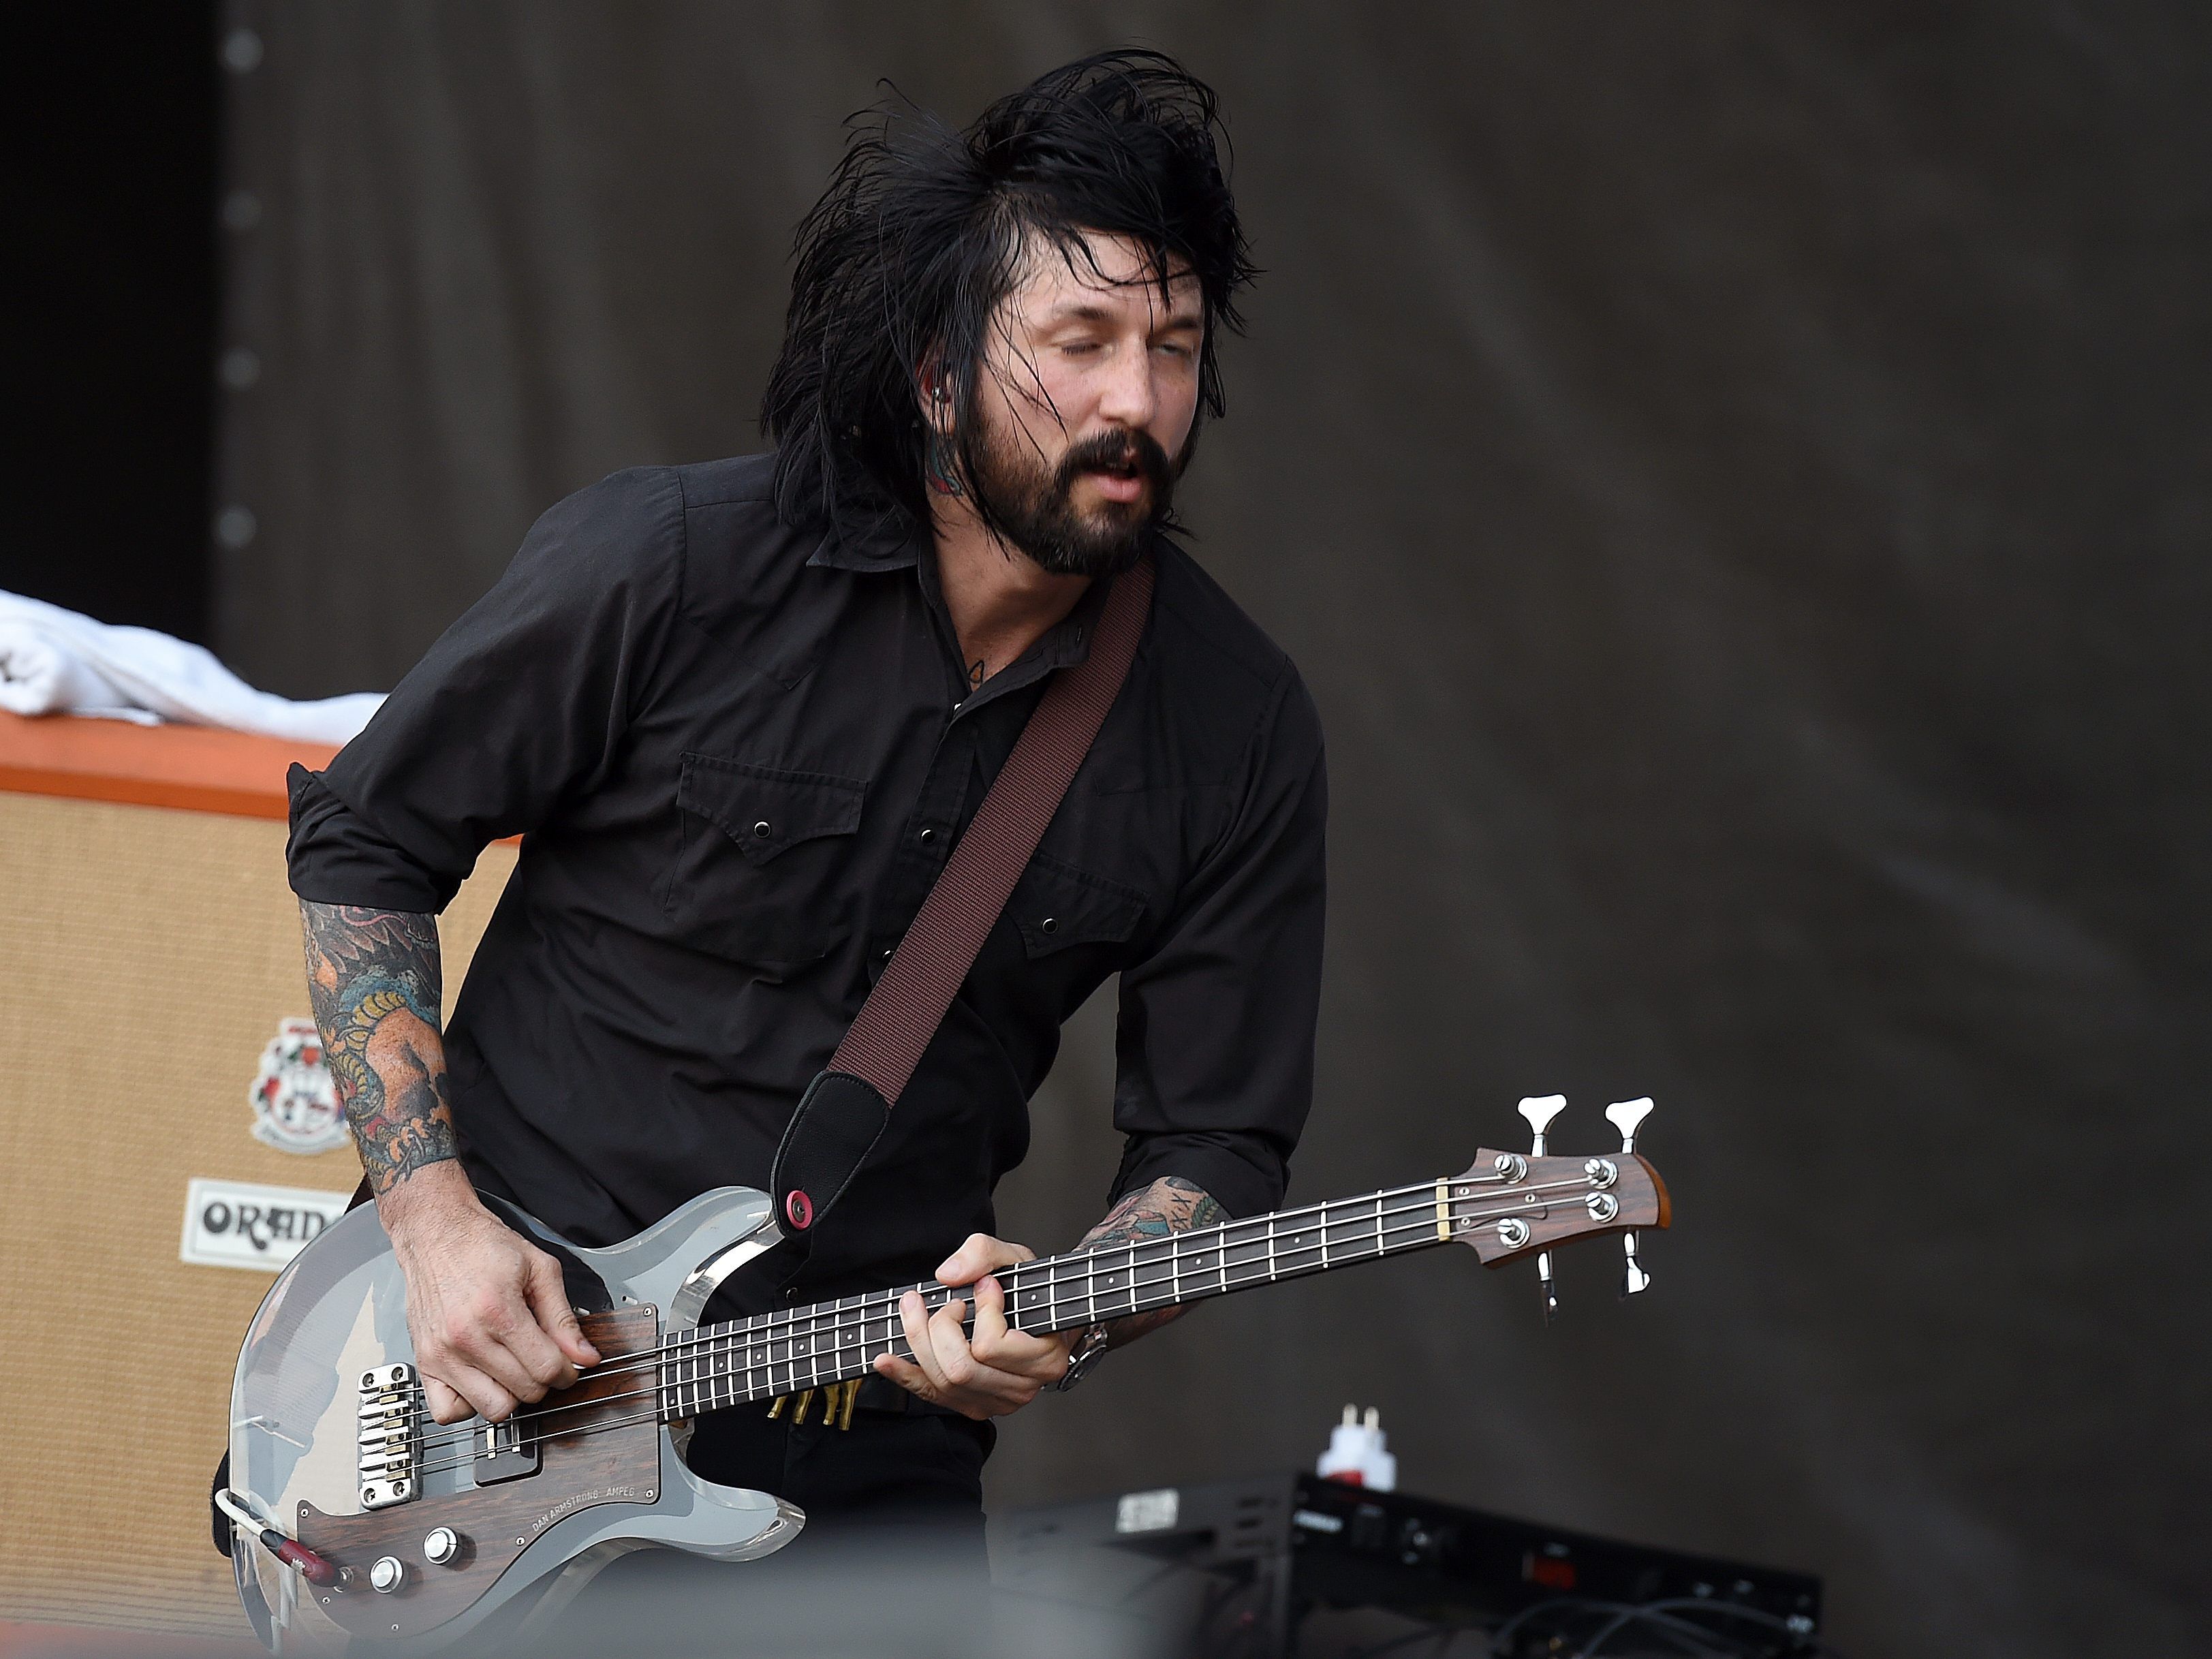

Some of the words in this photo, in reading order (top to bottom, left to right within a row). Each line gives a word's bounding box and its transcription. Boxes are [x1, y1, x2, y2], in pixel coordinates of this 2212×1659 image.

[204, 1202, 341, 1250] ORAN
[532, 1515, 549, 1532] DAN
[550, 1490, 598, 1519] ARMSTRONG
[606, 1487, 635, 1496] AMPEG
